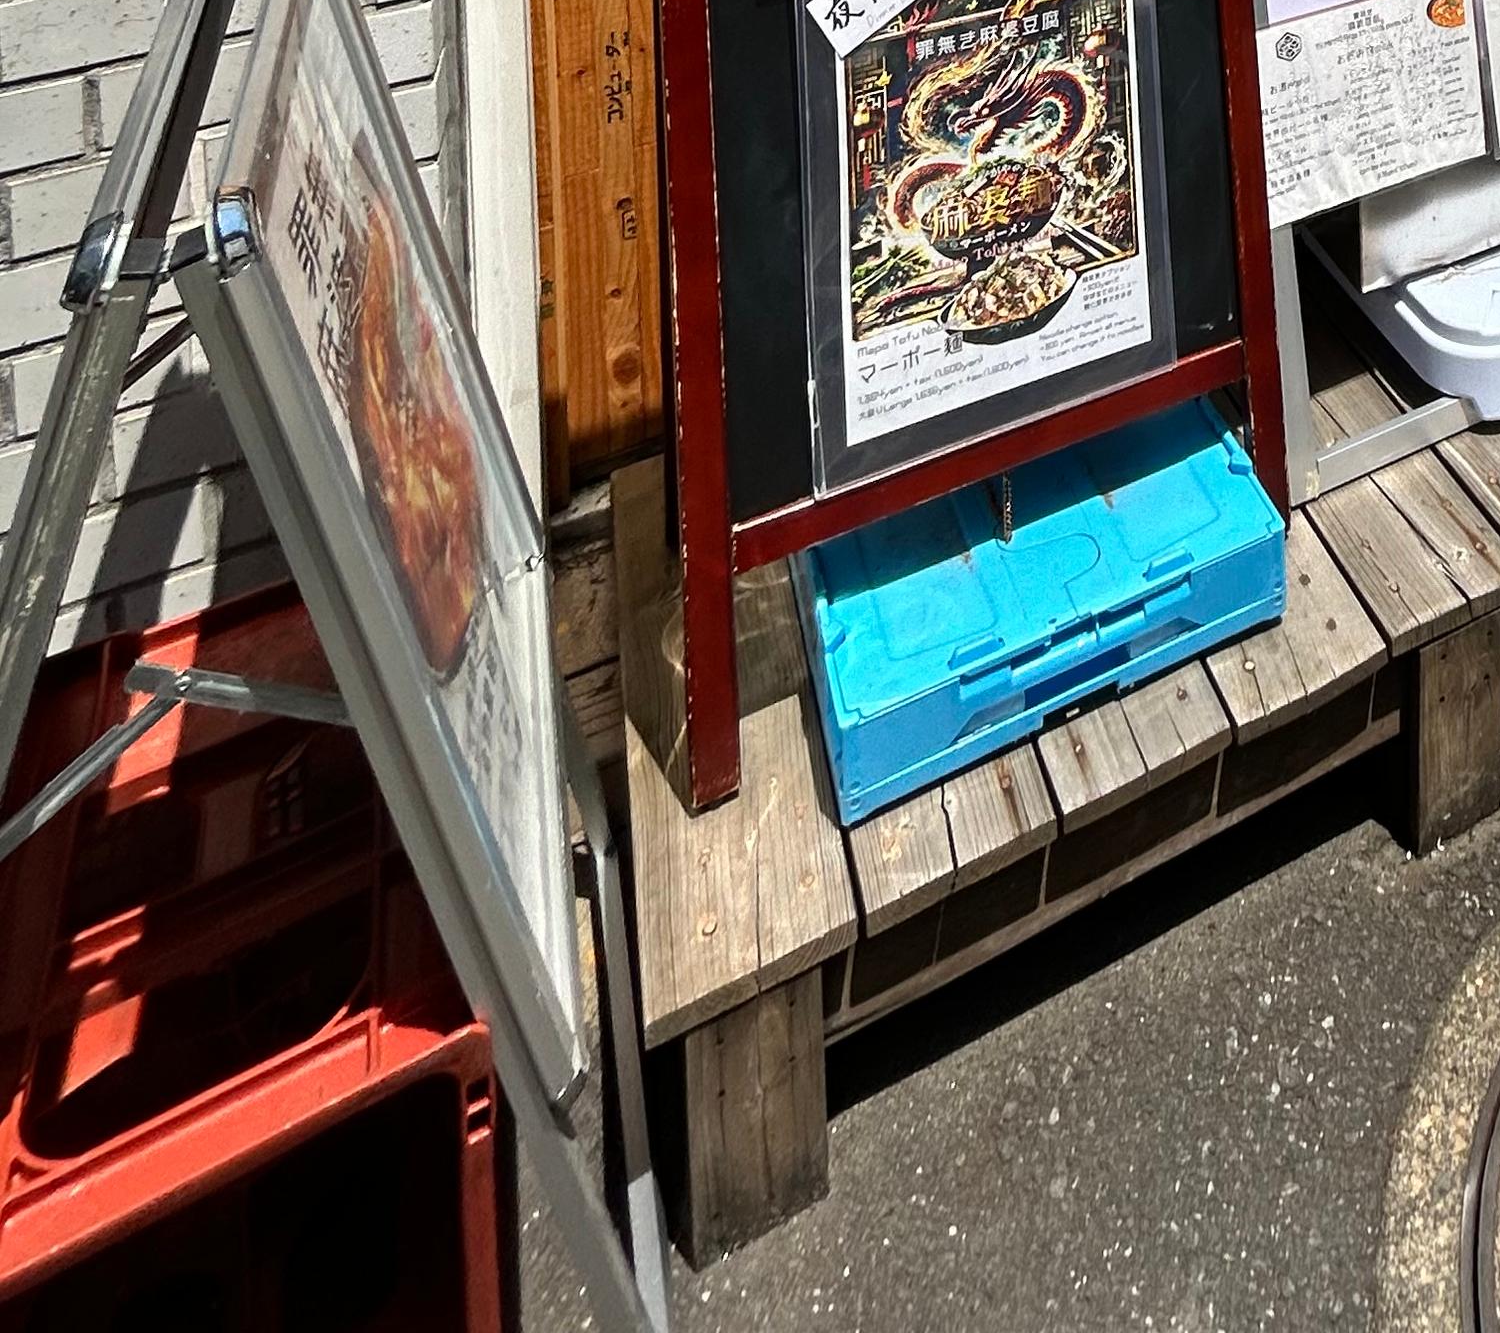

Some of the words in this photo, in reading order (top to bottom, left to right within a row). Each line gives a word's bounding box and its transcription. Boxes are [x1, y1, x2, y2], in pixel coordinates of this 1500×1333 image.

[915, 9, 1060, 61] 罪無き麻婆豆腐
[858, 331, 964, 384] マーボー麺
